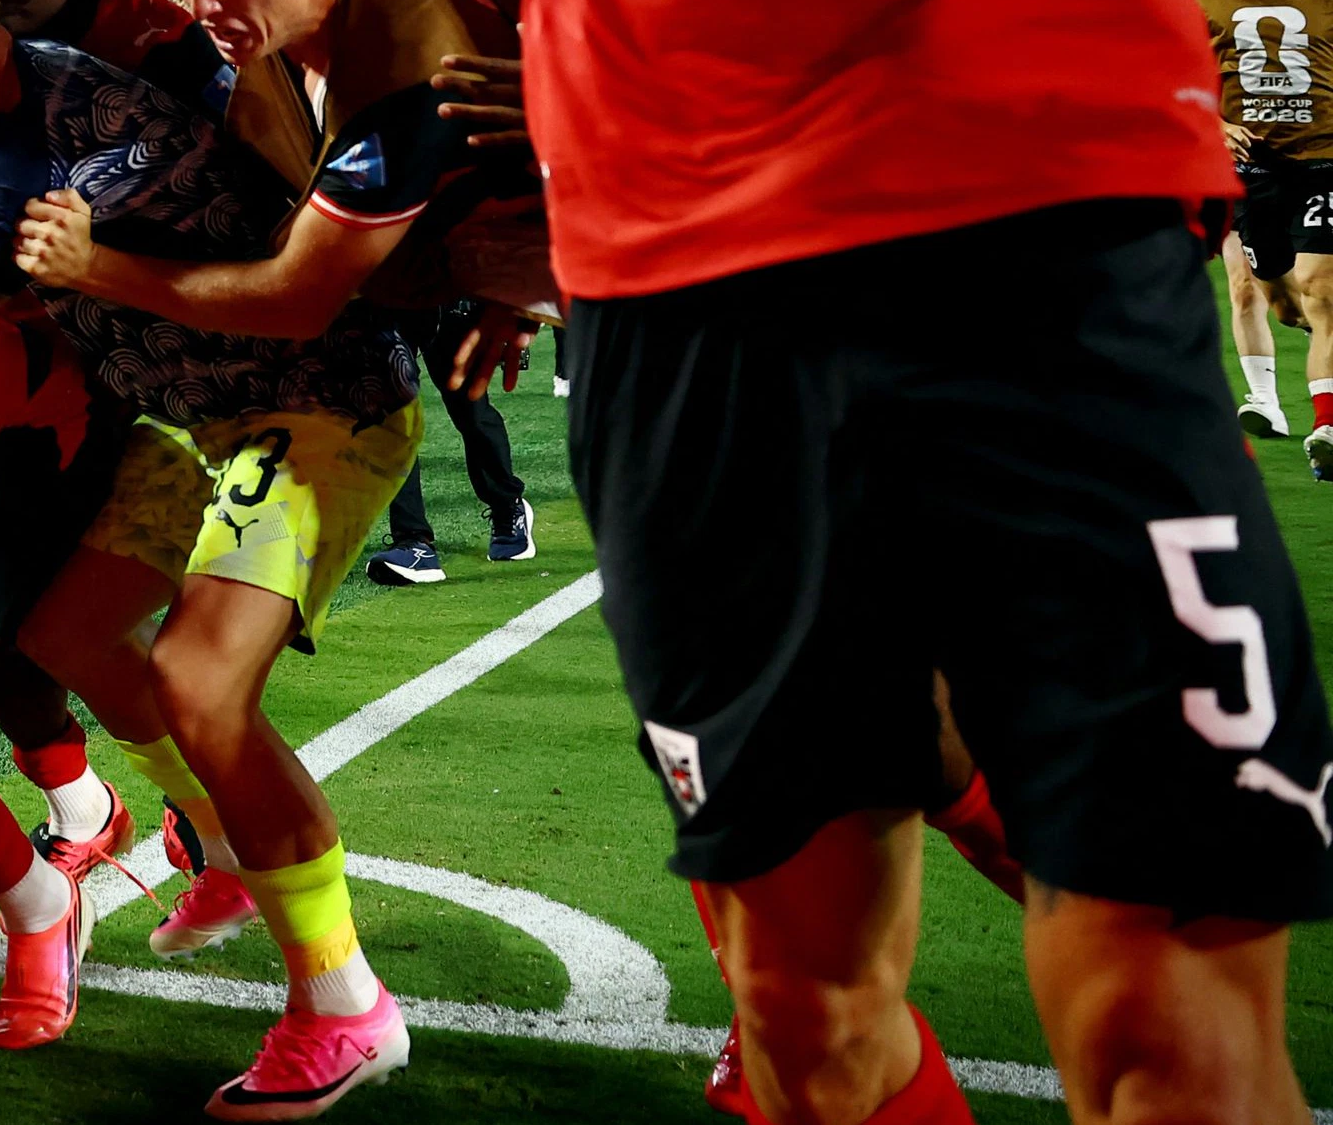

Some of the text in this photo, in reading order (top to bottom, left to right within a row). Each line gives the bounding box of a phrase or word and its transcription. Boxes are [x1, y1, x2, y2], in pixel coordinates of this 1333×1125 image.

[1260, 77, 1293, 87] FIFA
[1241, 98, 1313, 107] WORLD CUP
[1241, 108, 1313, 123] 2026
[1146, 514, 1277, 751] 5
